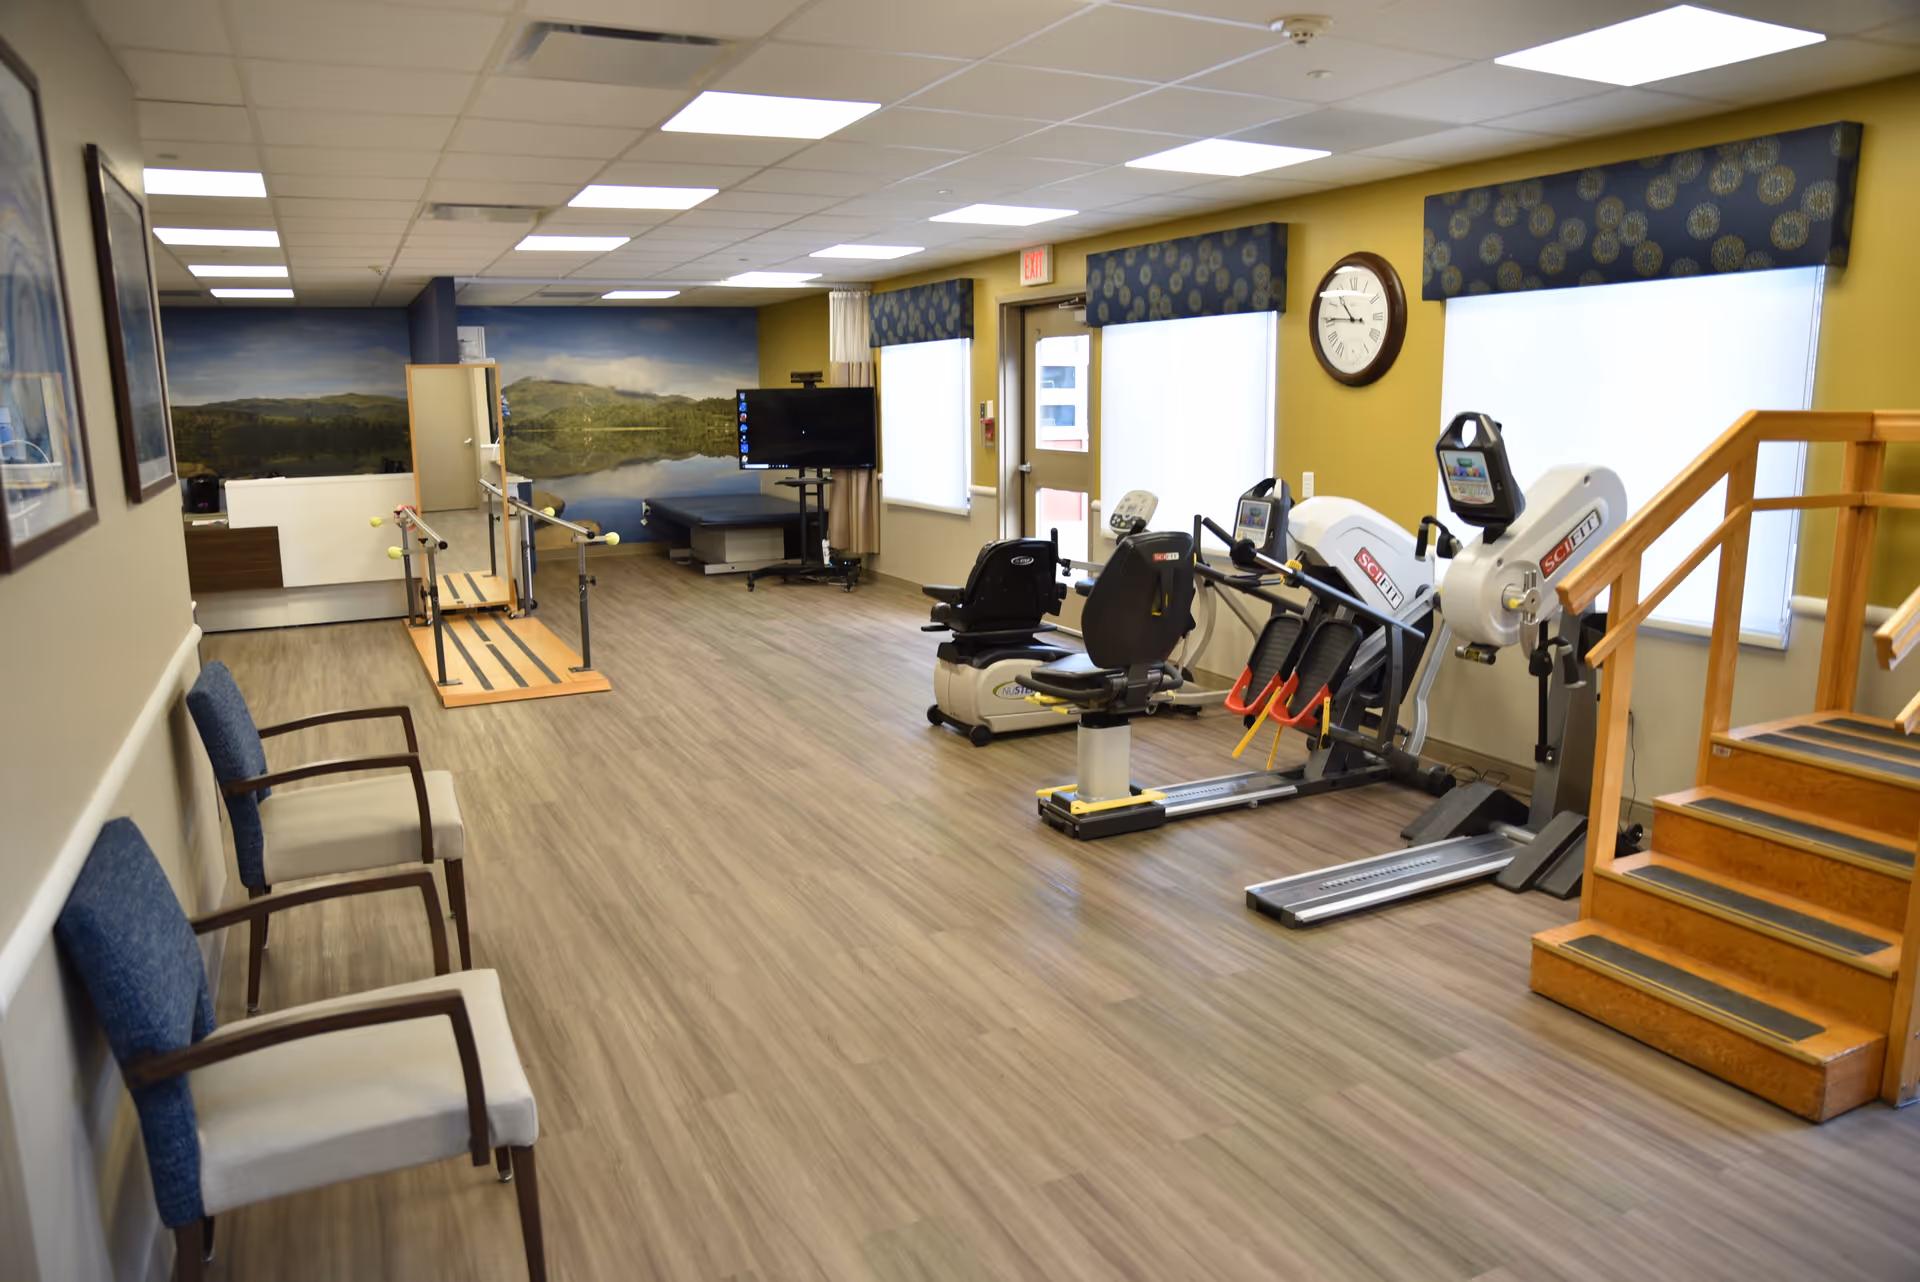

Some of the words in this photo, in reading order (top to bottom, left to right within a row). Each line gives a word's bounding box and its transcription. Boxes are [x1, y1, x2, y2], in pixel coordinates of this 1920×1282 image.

[1025, 250, 1043, 280] EXIT
[1544, 514, 1595, 573] SCIFIT
[1358, 553, 1401, 602] SCIFIT
